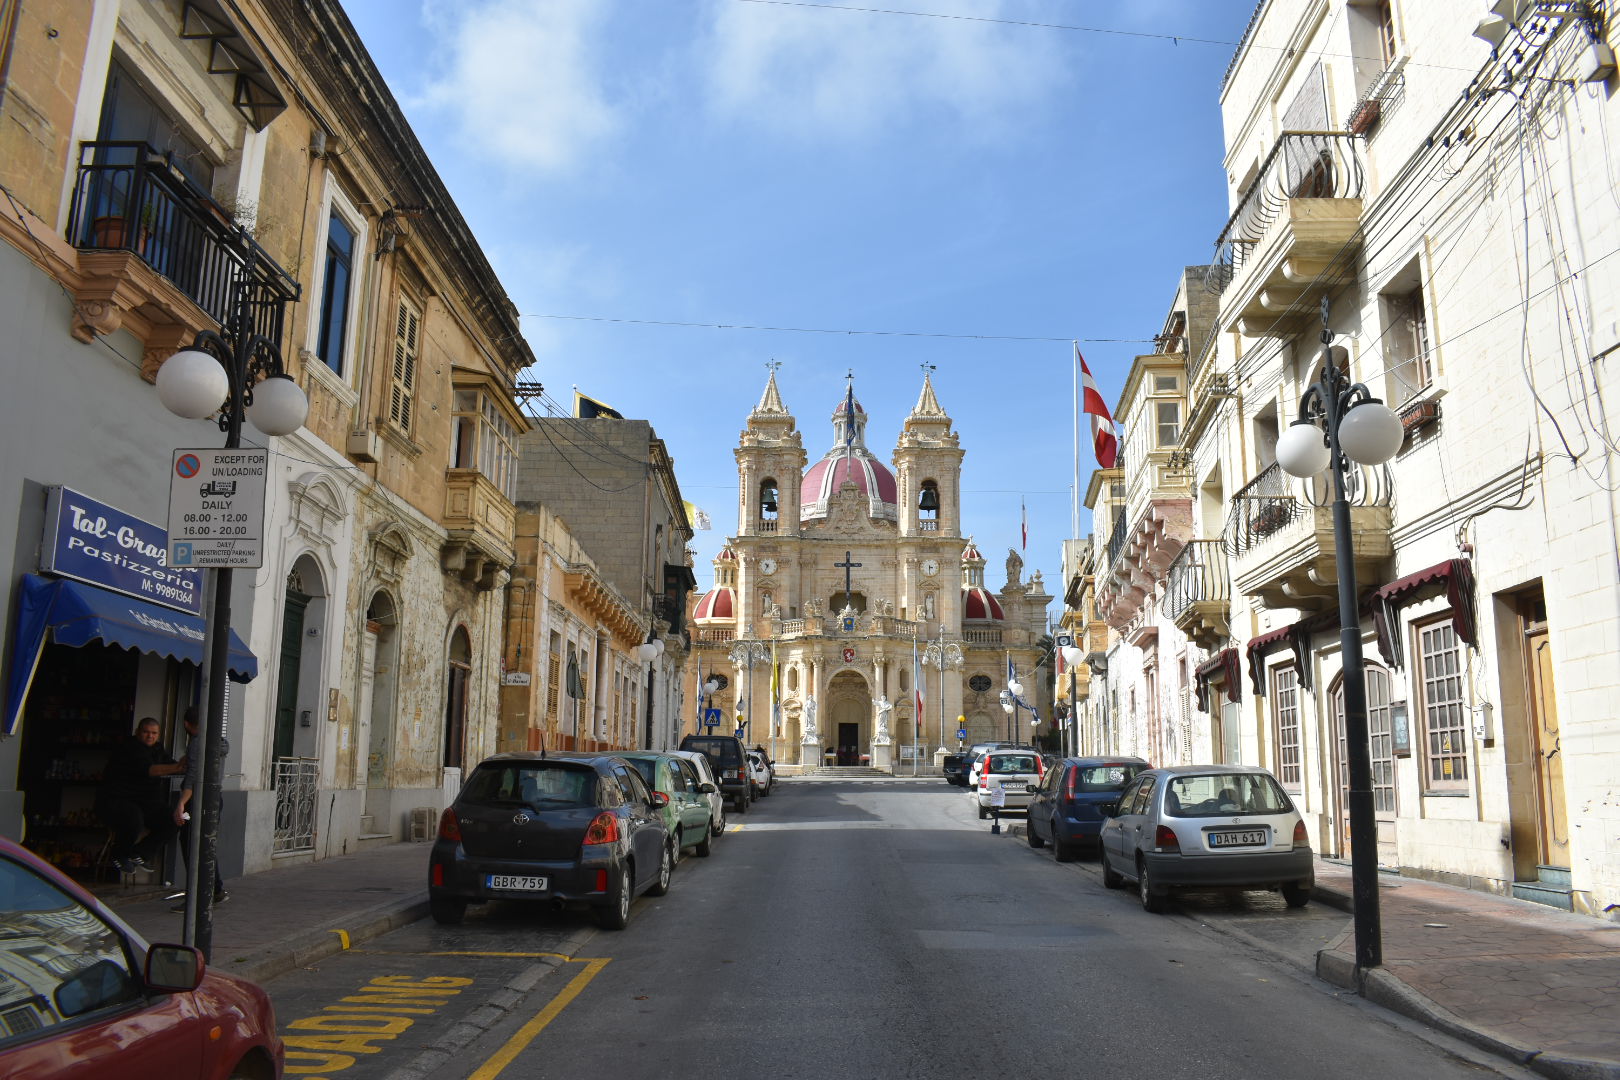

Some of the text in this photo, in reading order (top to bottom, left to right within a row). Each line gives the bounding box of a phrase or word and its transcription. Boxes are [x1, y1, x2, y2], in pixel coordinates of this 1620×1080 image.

[214, 455, 265, 464] EXCEPT FOR
[212, 467, 263, 476] UN/LOADING
[202, 501, 232, 510] DAILY
[184, 513, 211, 522] 08.00
[221, 513, 248, 522] 12.00
[184, 526, 210, 535] 16.00
[219, 526, 247, 535] 20.00
[68, 536, 194, 590] Pastizzeria
[141, 578, 193, 605] M: 99891364
[1216, 832, 1263, 845] DAH 617
[494, 876, 544, 889] GBR 759
